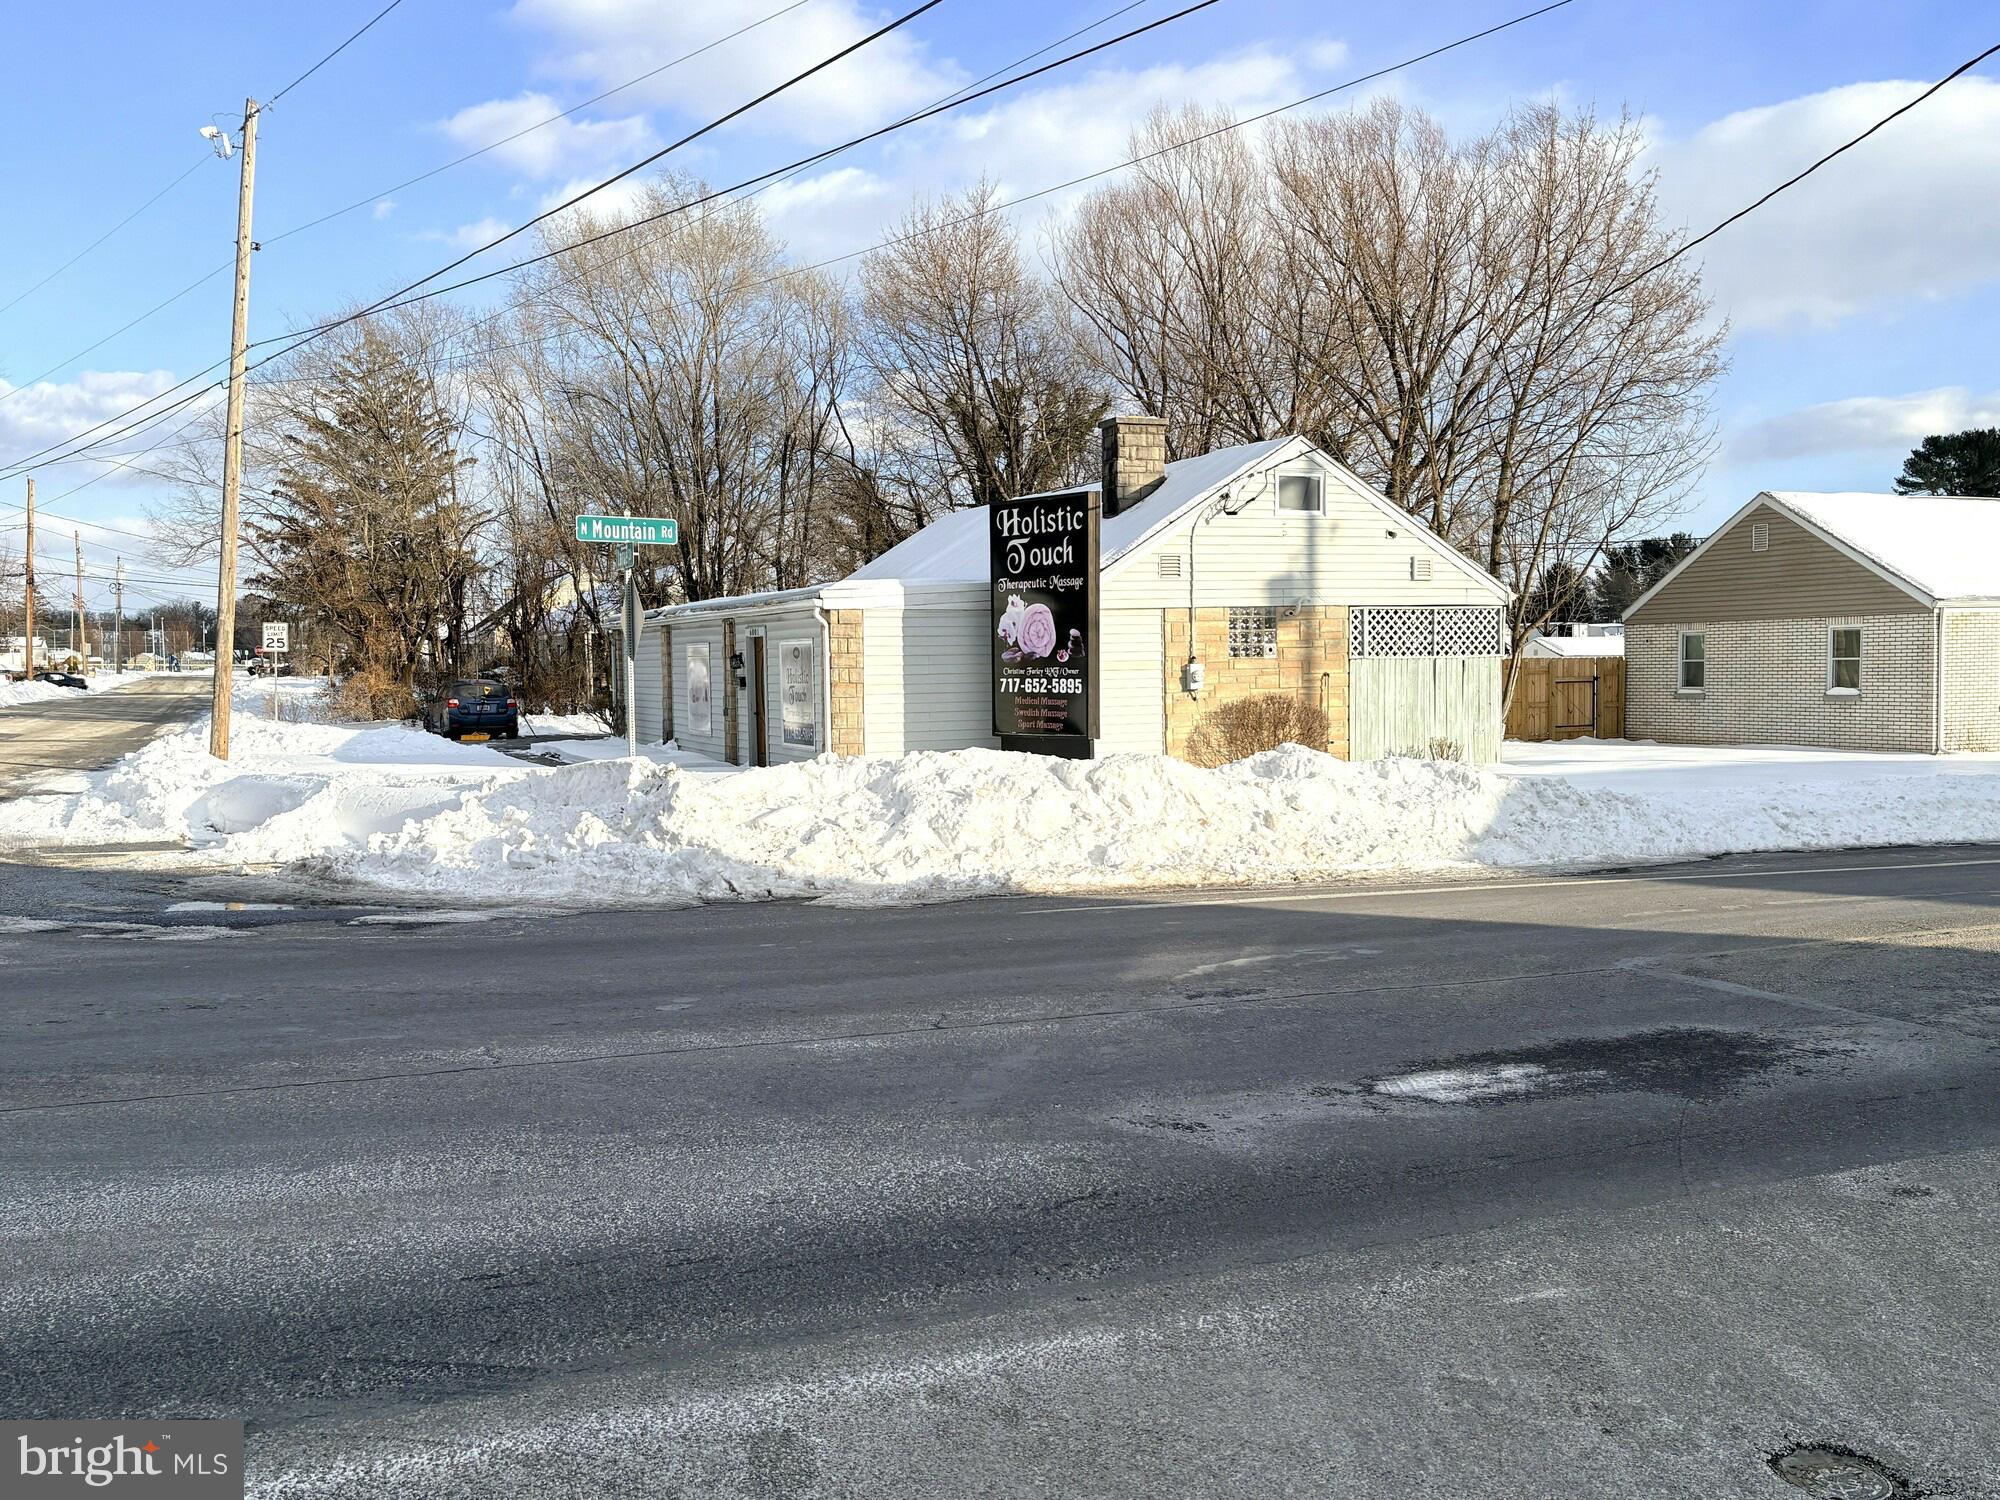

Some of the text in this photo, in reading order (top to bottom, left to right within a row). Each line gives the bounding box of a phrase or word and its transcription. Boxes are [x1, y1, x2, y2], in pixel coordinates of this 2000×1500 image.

[996, 505, 1084, 537] Holistic
[581, 519, 673, 540] N Mountain Rd
[1006, 536, 1074, 574] Touch
[997, 574, 1084, 592] Therapeutic Massage
[266, 637, 286, 649] 25
[1000, 678, 1083, 694] 717-652-5895
[1014, 696, 1068, 708] Medical Massage
[1040, 708, 1068, 720] Massage
[1036, 720, 1064, 731] Massage
